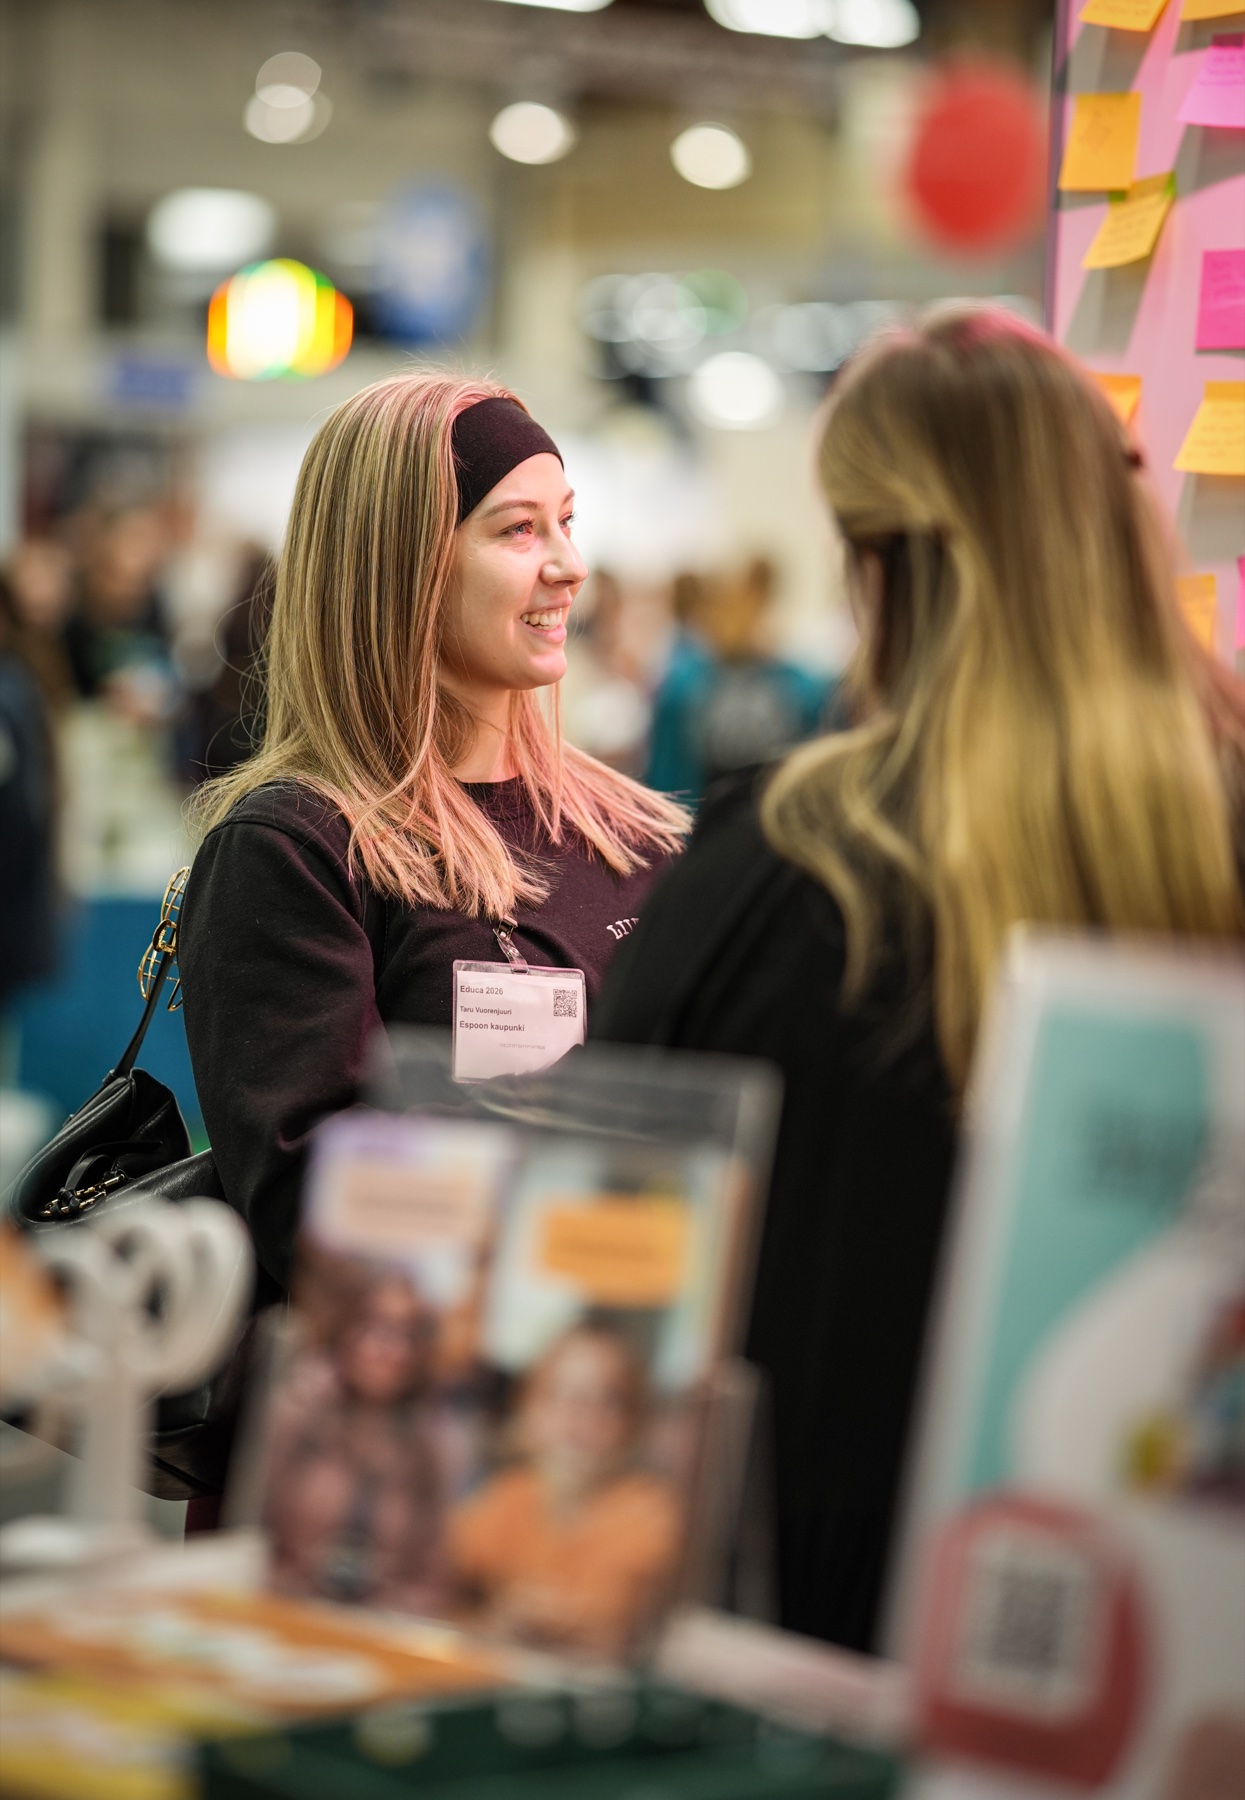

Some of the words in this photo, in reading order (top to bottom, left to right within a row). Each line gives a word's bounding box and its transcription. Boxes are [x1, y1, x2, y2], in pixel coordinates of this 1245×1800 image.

[460, 985, 484, 994] Educa
[485, 987, 504, 995] 2026
[460, 1005, 474, 1013] Taru
[475, 1006, 512, 1016] Vuorenjuuri
[459, 1020, 488, 1030] Espoon
[490, 1022, 525, 1032] kaupunki
